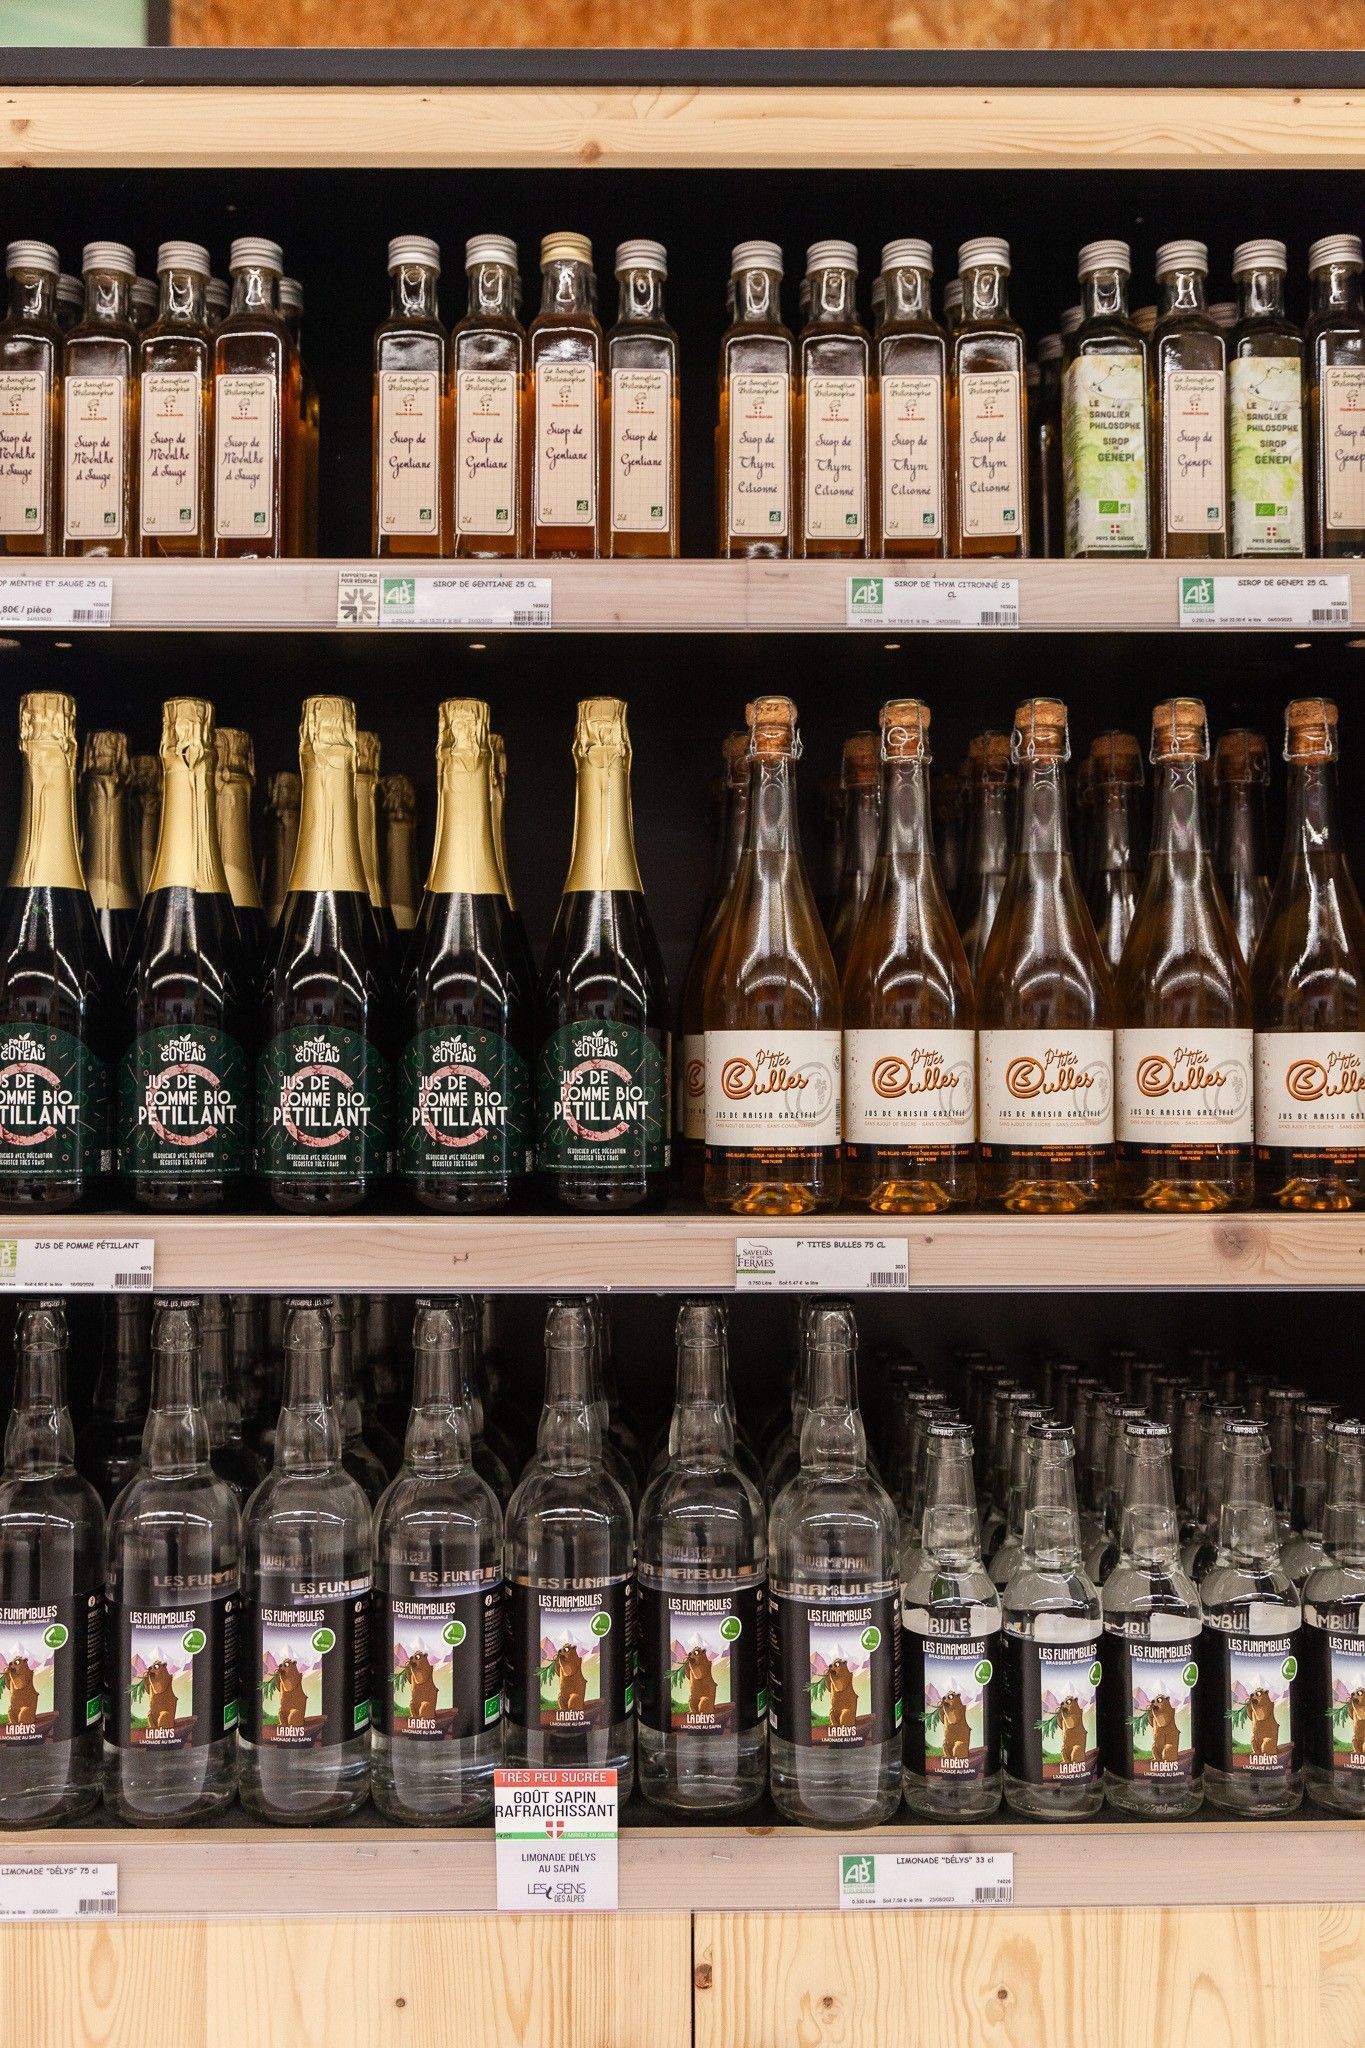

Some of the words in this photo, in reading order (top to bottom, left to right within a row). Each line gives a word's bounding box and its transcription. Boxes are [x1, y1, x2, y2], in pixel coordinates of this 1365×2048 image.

[1090, 422, 1141, 430] PHILOSOPHE
[1246, 424, 1298, 432] PHILOSOPHE
[1260, 440, 1287, 448] SIROP
[1098, 451, 1135, 462] GÉNÉPI
[1255, 454, 1292, 465] GÉNÉPI
[87, 580, 96, 588] 25
[99, 580, 107, 588] CL
[958, 580, 998, 589] CITRONNÉ
[27, 606, 52, 614] pièce
[146, 1074, 173, 1090] JUS
[177, 1074, 196, 1089] DE
[418, 1076, 442, 1091] JUS
[448, 1076, 467, 1090] DE
[560, 1070, 583, 1085] JUS
[589, 1070, 608, 1085] DE
[145, 1090, 200, 1105] POMME
[204, 1090, 231, 1105] BIO
[418, 1092, 468, 1107] POMME
[474, 1092, 502, 1107] BIO
[560, 1086, 610, 1101] POMME
[616, 1086, 643, 1101] BIO
[138, 1102, 237, 1125] PÉTILLANT
[412, 1103, 508, 1126] PÉTILLANT
[554, 1098, 649, 1120] PÉTILLANT
[716, 1111, 727, 1119] JUS
[743, 1111, 774, 1119] RAISIN
[96, 1240, 140, 1249] PÉTILLANT
[742, 1248, 773, 1256] SAVEURS
[738, 1258, 774, 1269] FERMES
[539, 1594, 552, 1607] LES
[552, 1594, 602, 1607] FUNAMBULES
[130, 1611, 142, 1623] LES
[144, 1610, 196, 1623] FUNAMBULES
[808, 1609, 820, 1621] LES
[821, 1608, 872, 1622] FUNAMBULES
[923, 1640, 935, 1653] LES
[936, 1641, 984, 1654] FUNAMBULES
[1229, 1638, 1242, 1650] LES
[1243, 1638, 1290, 1651] FUNAMBULES
[556, 1710, 564, 1721] LA
[565, 1708, 584, 1721] DÉLYS
[146, 1728, 154, 1739] LA
[156, 1726, 175, 1738] DÉLYS
[828, 1727, 836, 1738] LA
[836, 1726, 856, 1737] DÉLYS
[1250, 1755, 1258, 1765] LA
[1258, 1754, 1278, 1765] DÉLYS
[501, 1771, 530, 1783] TRÈS
[534, 1772, 557, 1783] PEU
[562, 1770, 607, 1783] SUCRÉE
[514, 1790, 550, 1804] GOÛT
[555, 1791, 596, 1804] SAPIN
[496, 1804, 615, 1818] RAFRAICHISSANT
[522, 1853, 566, 1862] LIMONADE
[569, 1852, 596, 1862] DÉLYS
[896, 1857, 939, 1865] LIMONADE
[976, 1856, 985, 1864] 33
[988, 1856, 994, 1864] cl
[538, 1864, 551, 1873] AU
[554, 1864, 580, 1873] SAPIN
[528, 1884, 547, 1895] LES
[556, 1883, 587, 1895] SENS
[554, 1895, 566, 1903] DES
[566, 1895, 585, 1903] ALPES
